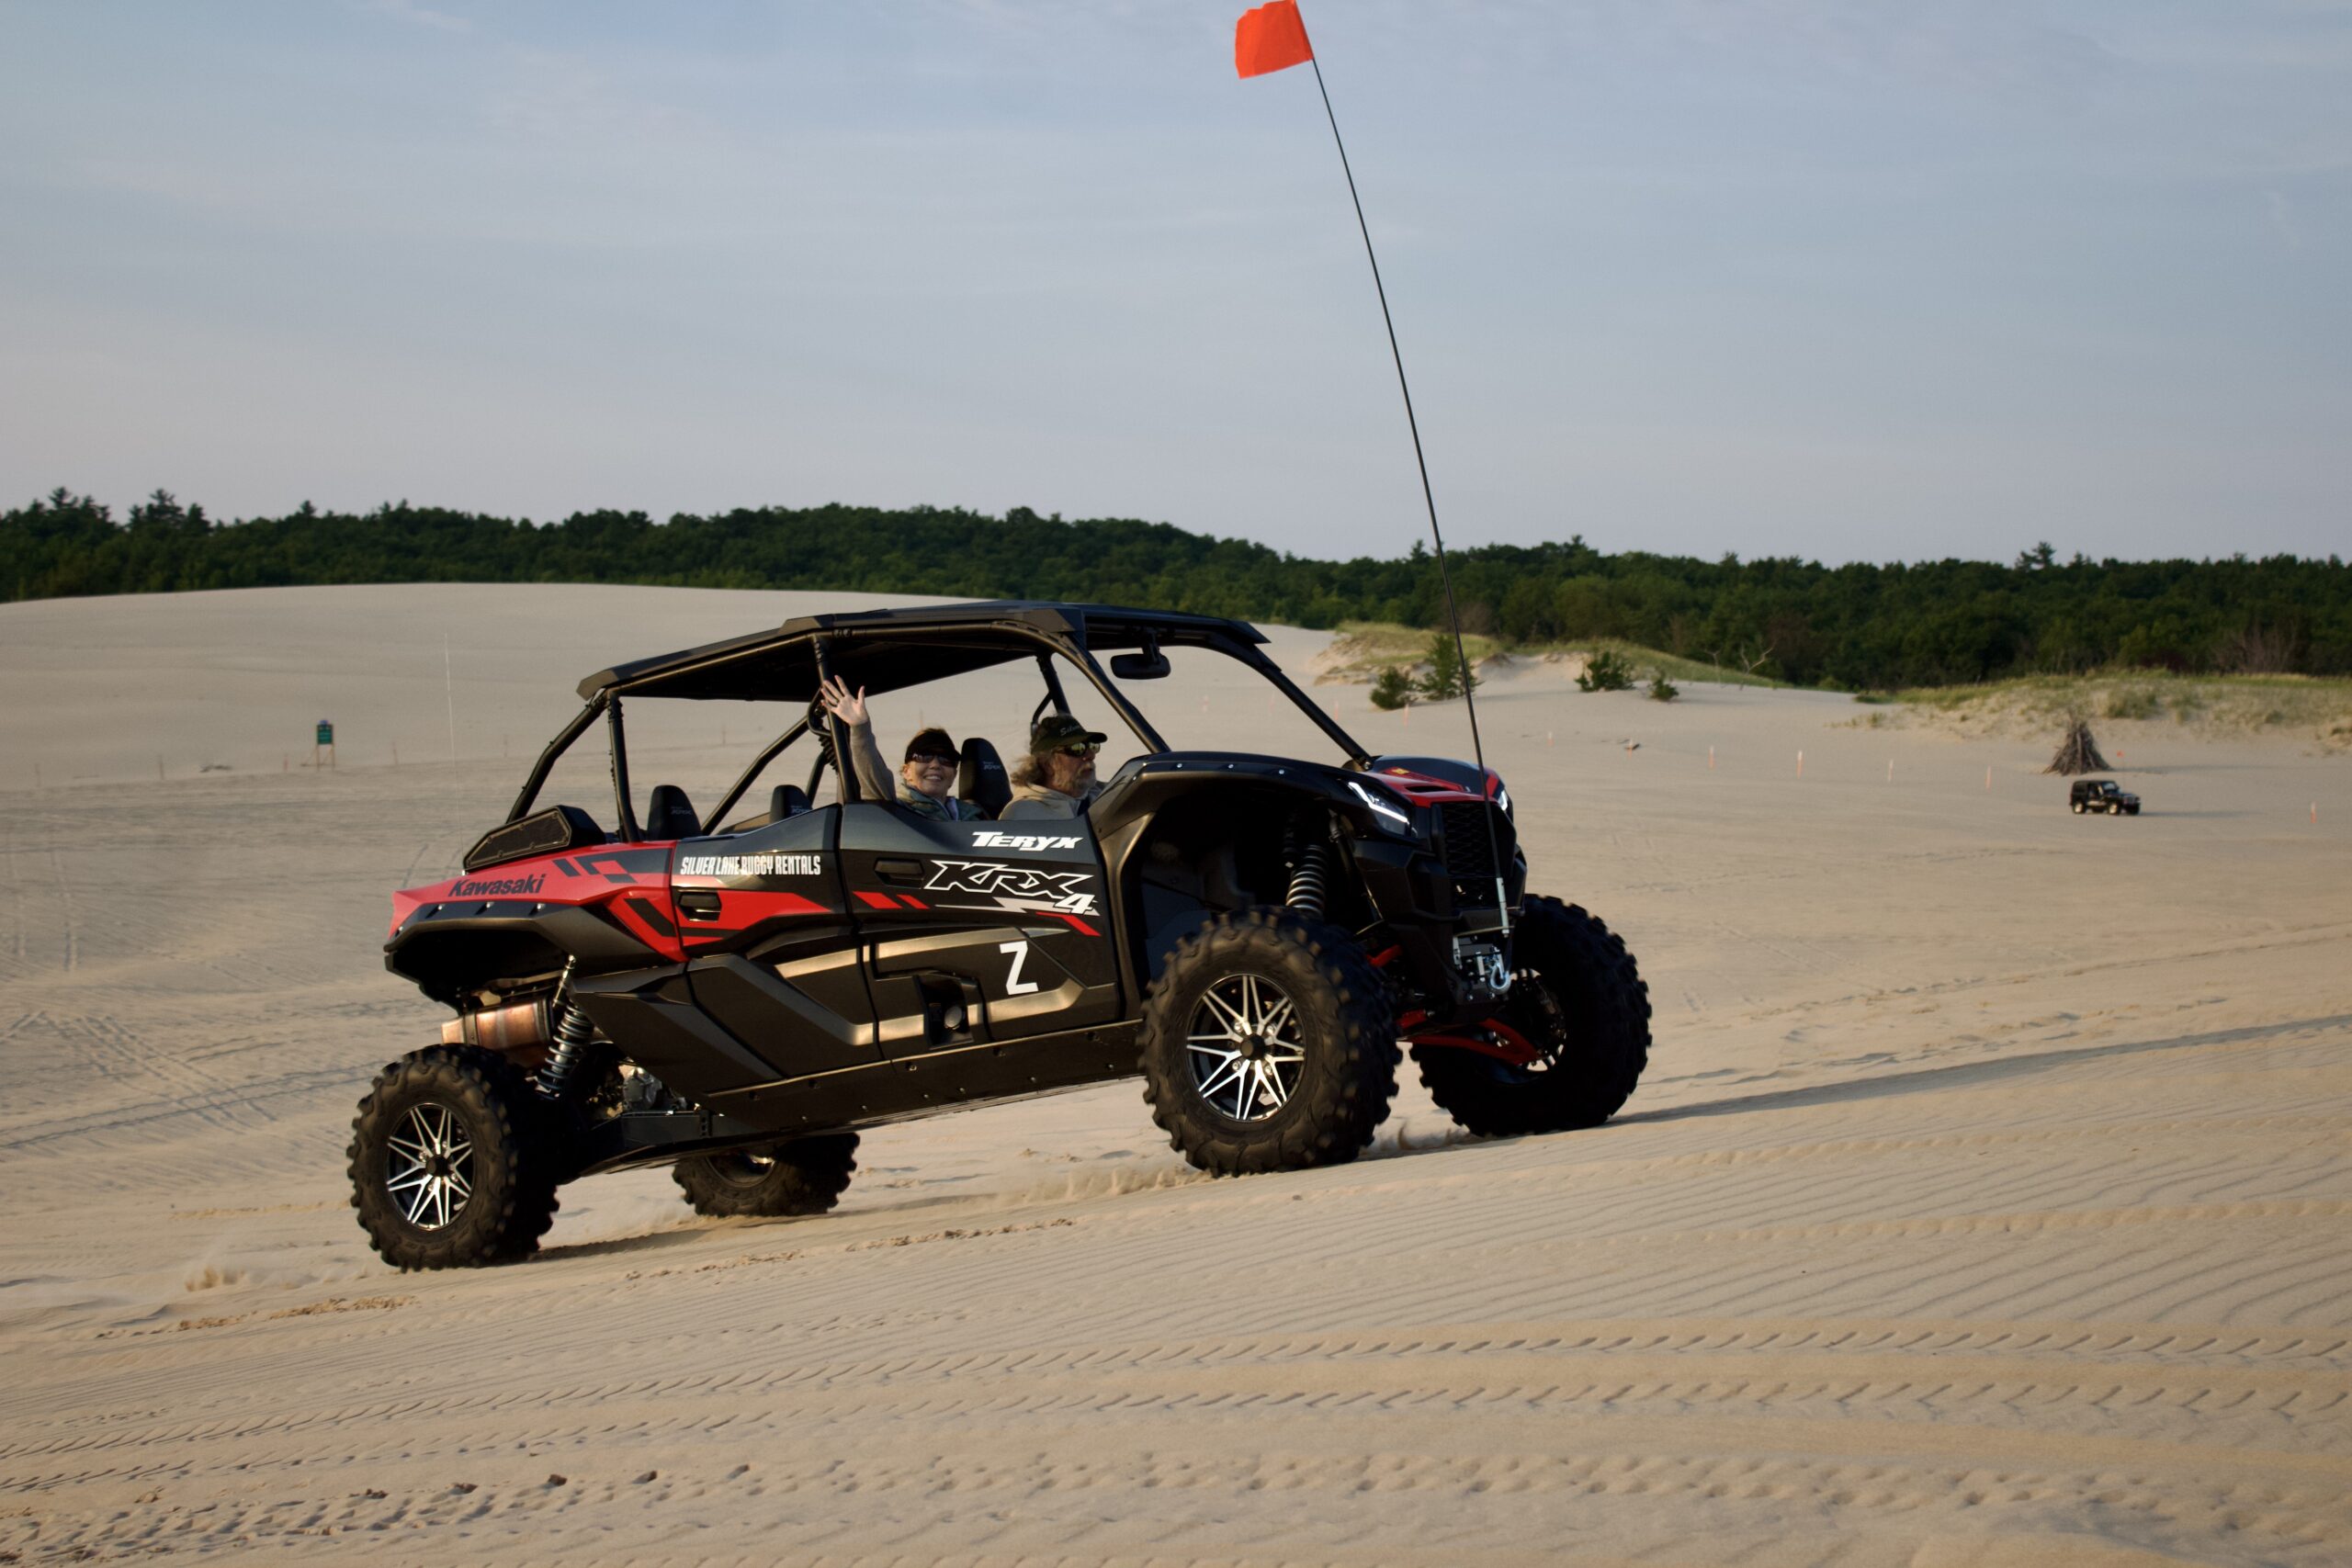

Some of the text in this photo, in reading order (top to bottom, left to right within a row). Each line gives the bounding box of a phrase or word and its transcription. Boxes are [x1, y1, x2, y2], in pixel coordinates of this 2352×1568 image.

[680, 855, 821, 875] SILVER LAKE BUGGY RENTALS
[447, 873, 547, 897] Kawasaki
[923, 860, 1096, 914] KRX 4
